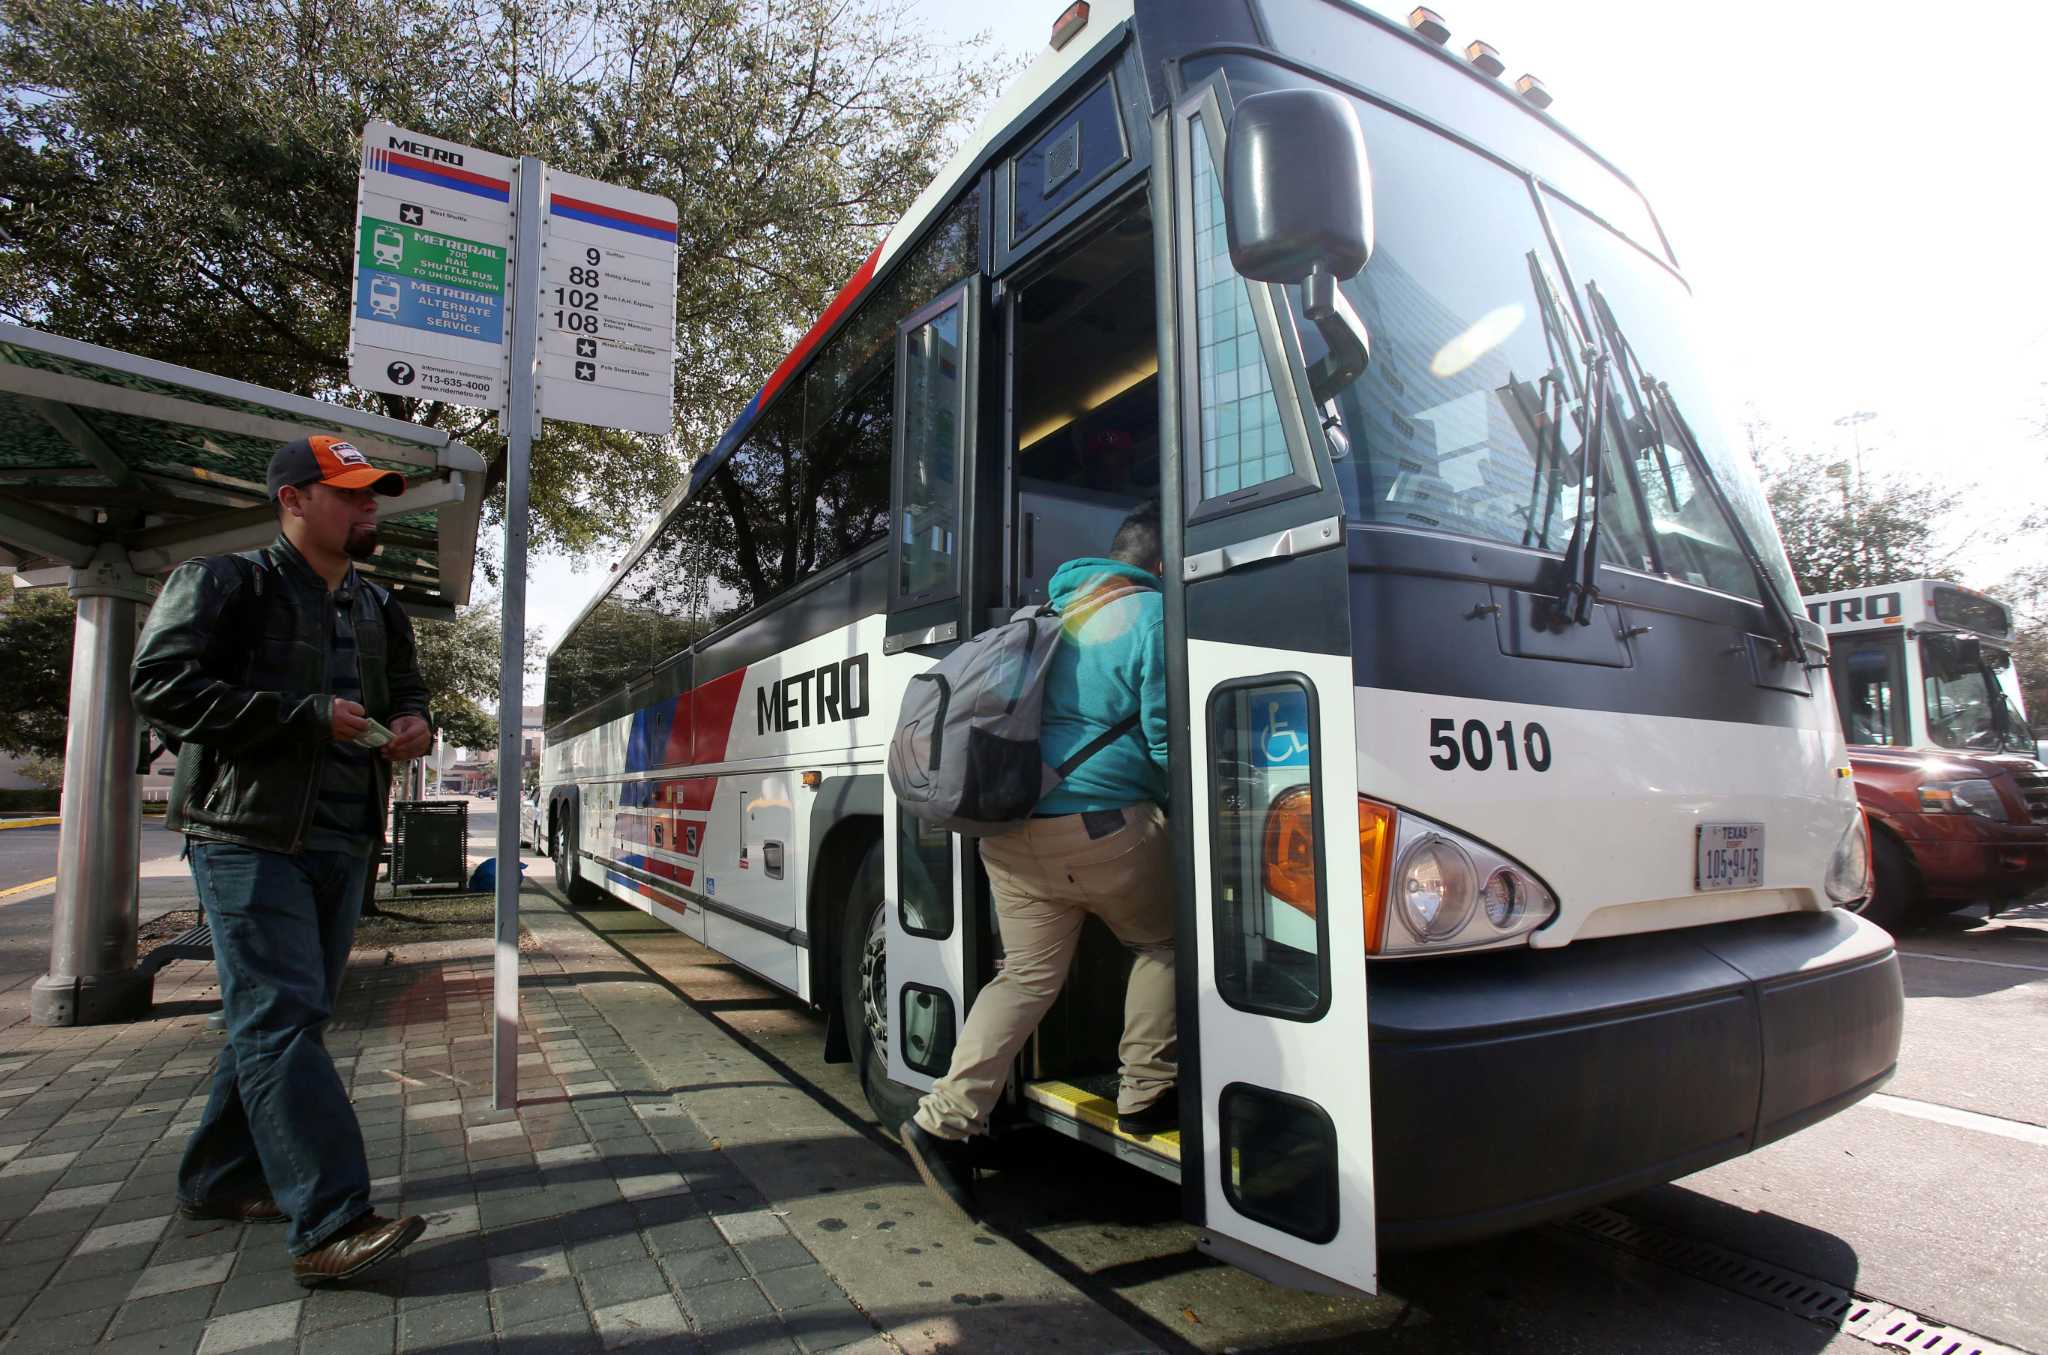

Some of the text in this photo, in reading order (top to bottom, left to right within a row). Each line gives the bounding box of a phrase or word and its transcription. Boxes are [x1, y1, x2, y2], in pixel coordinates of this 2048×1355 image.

[389, 136, 464, 167] METRO
[414, 231, 499, 259] METRORAIL
[446, 257, 469, 268] RAIL
[586, 247, 601, 266] 9
[420, 260, 493, 281] SHUTTLE BUS
[569, 266, 600, 288] 88
[411, 281, 497, 307] METRORAIL
[554, 287, 599, 312] 102
[418, 296, 492, 318] ALTERNATE
[441, 310, 468, 322] BUS
[426, 317, 481, 334] SERVICE
[553, 310, 599, 334] 108
[421, 373, 490, 392] 713-635-4000
[421, 385, 487, 401] www.ridemetro.org
[757, 652, 870, 736] METRO
[1429, 718, 1552, 773] 5010
[1723, 826, 1748, 840] TEXAS
